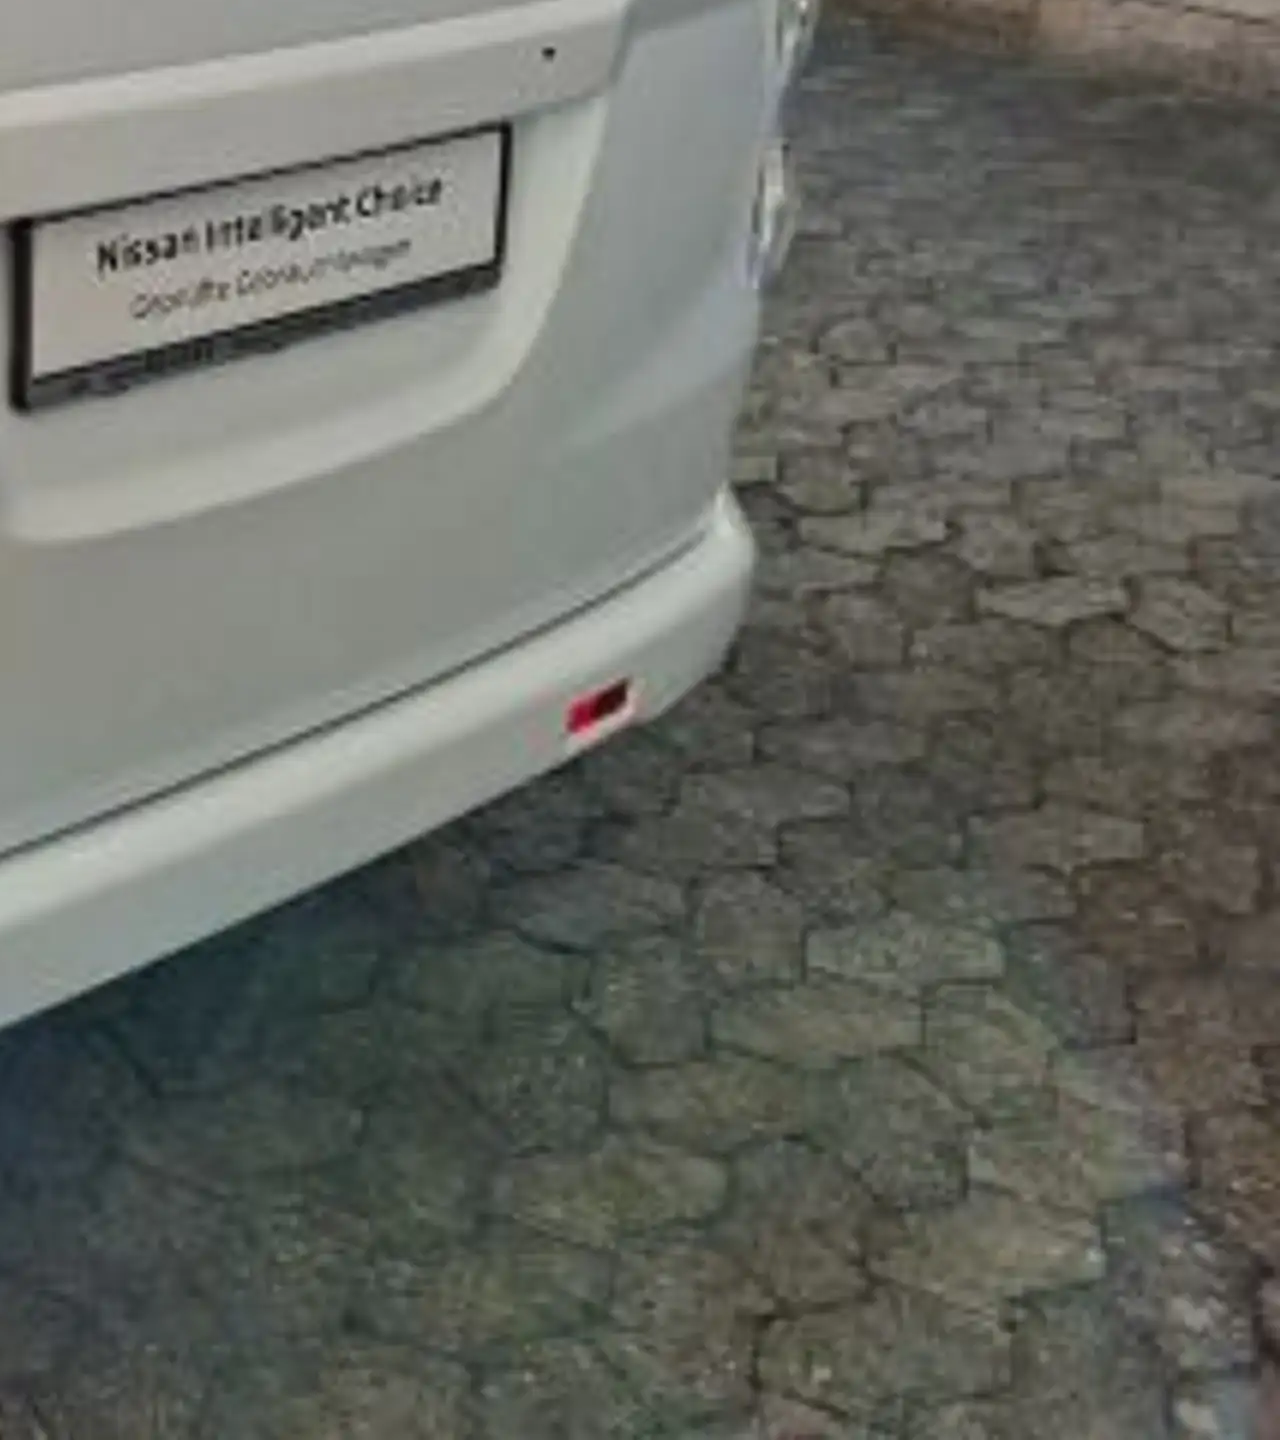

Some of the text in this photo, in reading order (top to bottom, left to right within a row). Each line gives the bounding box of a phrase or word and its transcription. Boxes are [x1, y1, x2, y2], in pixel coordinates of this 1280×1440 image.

[95, 175, 444, 273] Nissan Intelligent Choice
